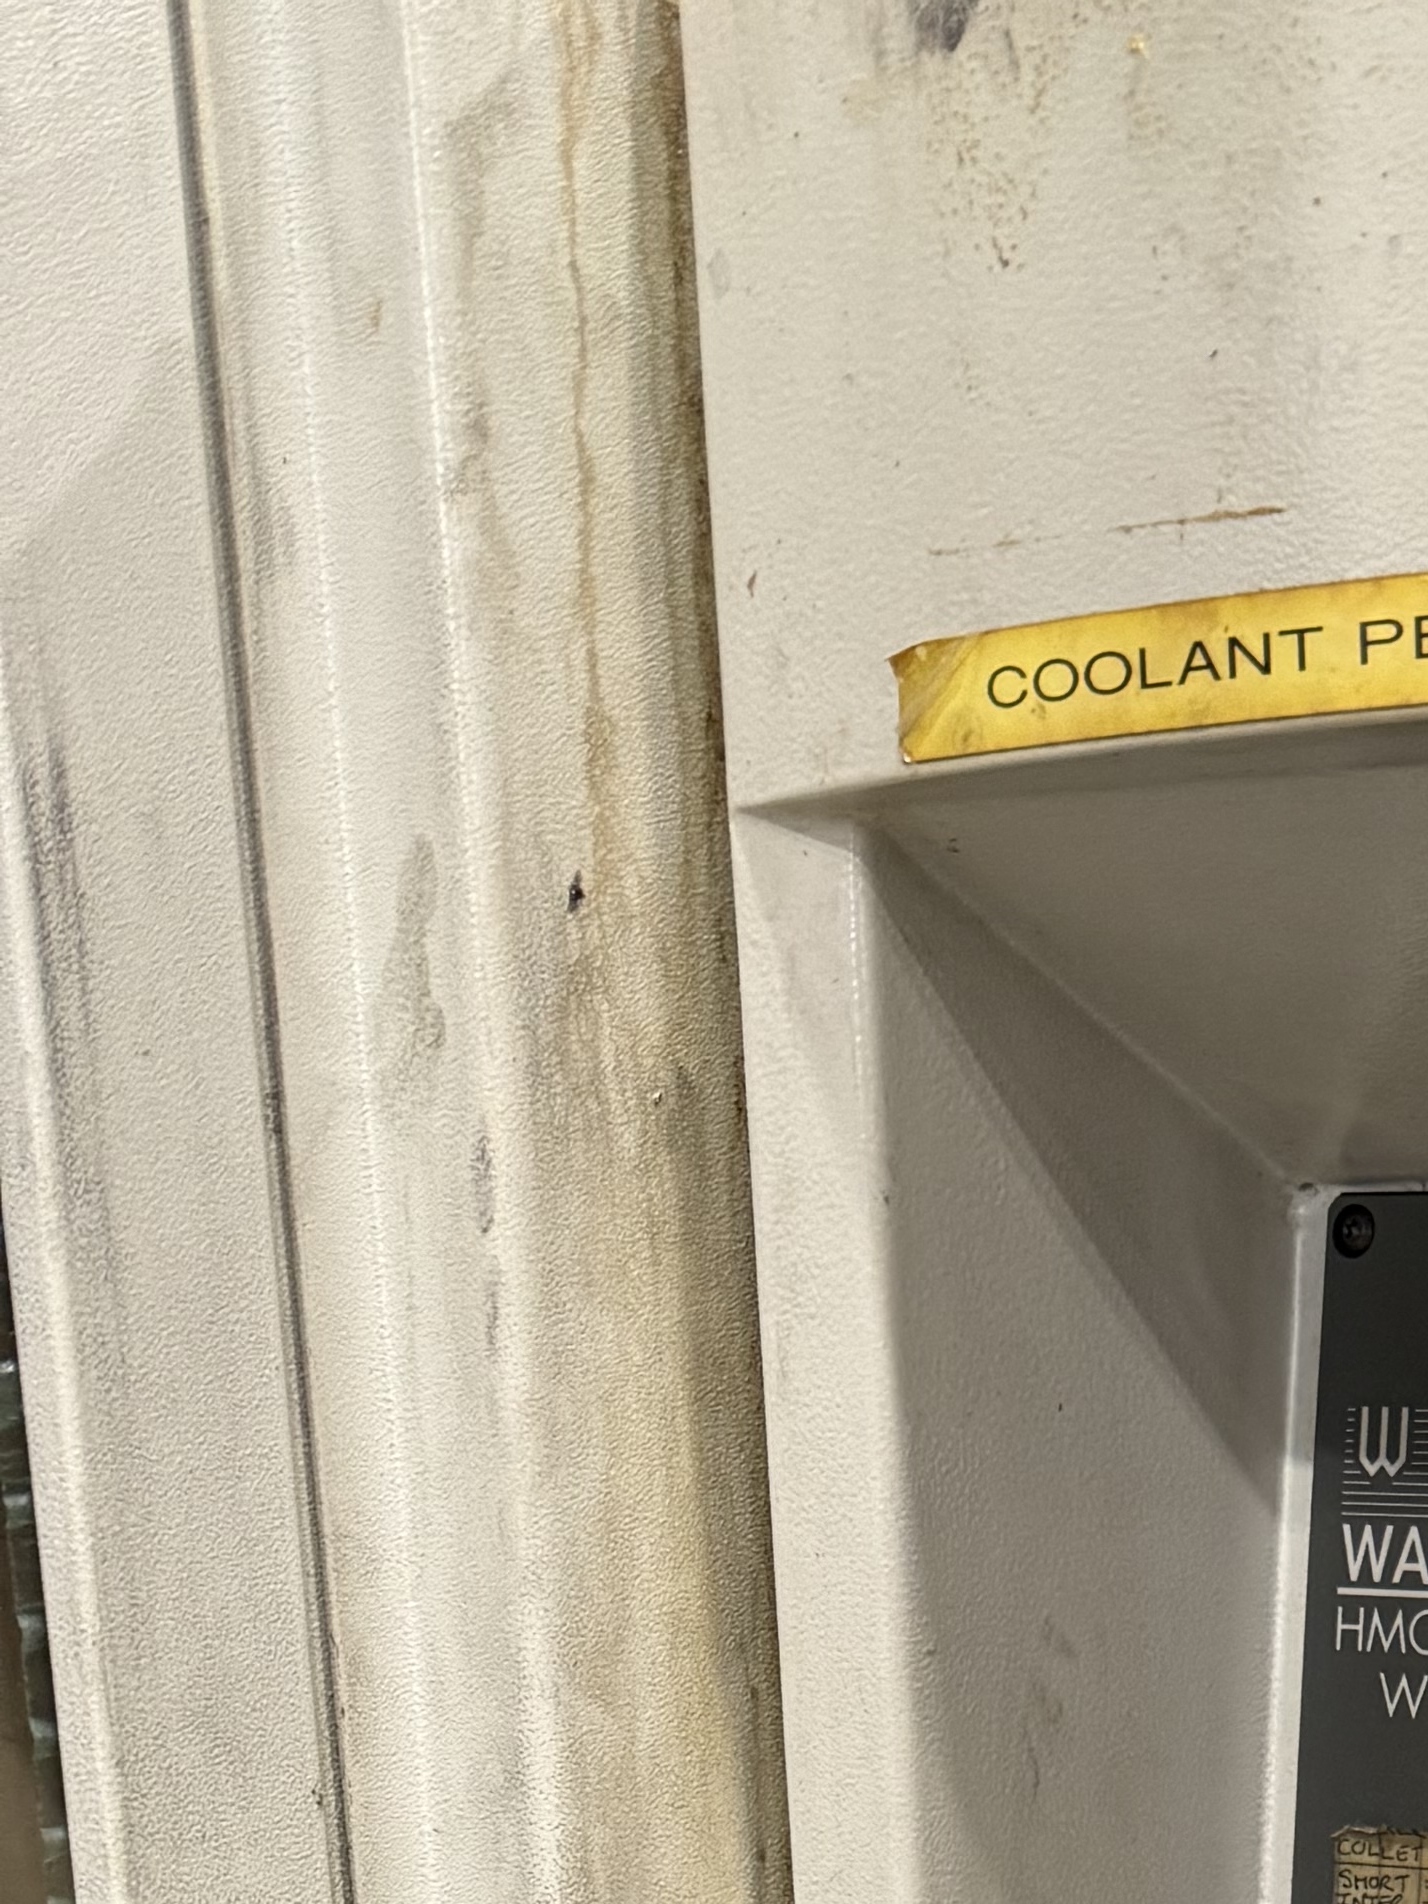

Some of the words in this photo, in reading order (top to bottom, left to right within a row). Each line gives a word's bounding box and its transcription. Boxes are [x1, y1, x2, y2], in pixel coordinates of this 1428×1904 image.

[985, 623, 1326, 710] COOLANT
[1337, 1840, 1424, 1862] COLLET
[1338, 1869, 1410, 1892] SHORT
